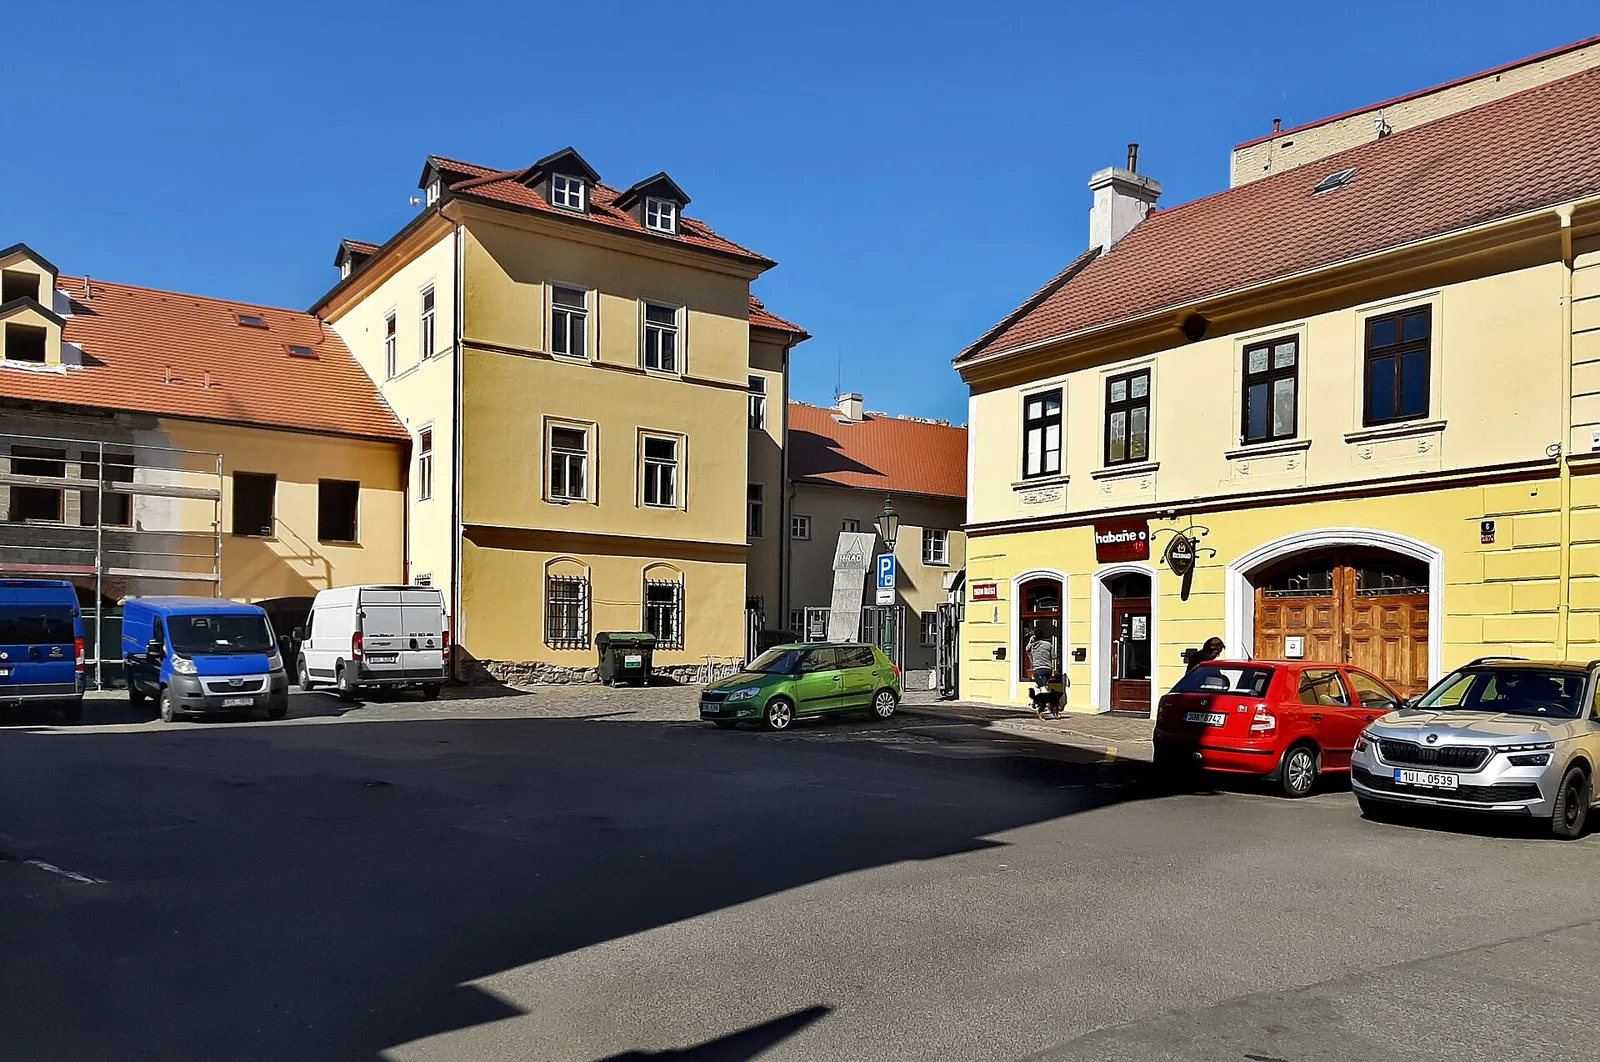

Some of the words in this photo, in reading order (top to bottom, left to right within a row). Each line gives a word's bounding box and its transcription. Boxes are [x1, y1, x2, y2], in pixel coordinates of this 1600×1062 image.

[839, 554, 862, 562] HRAD
[881, 558, 892, 579] P
[1427, 774, 1453, 786] 0539
